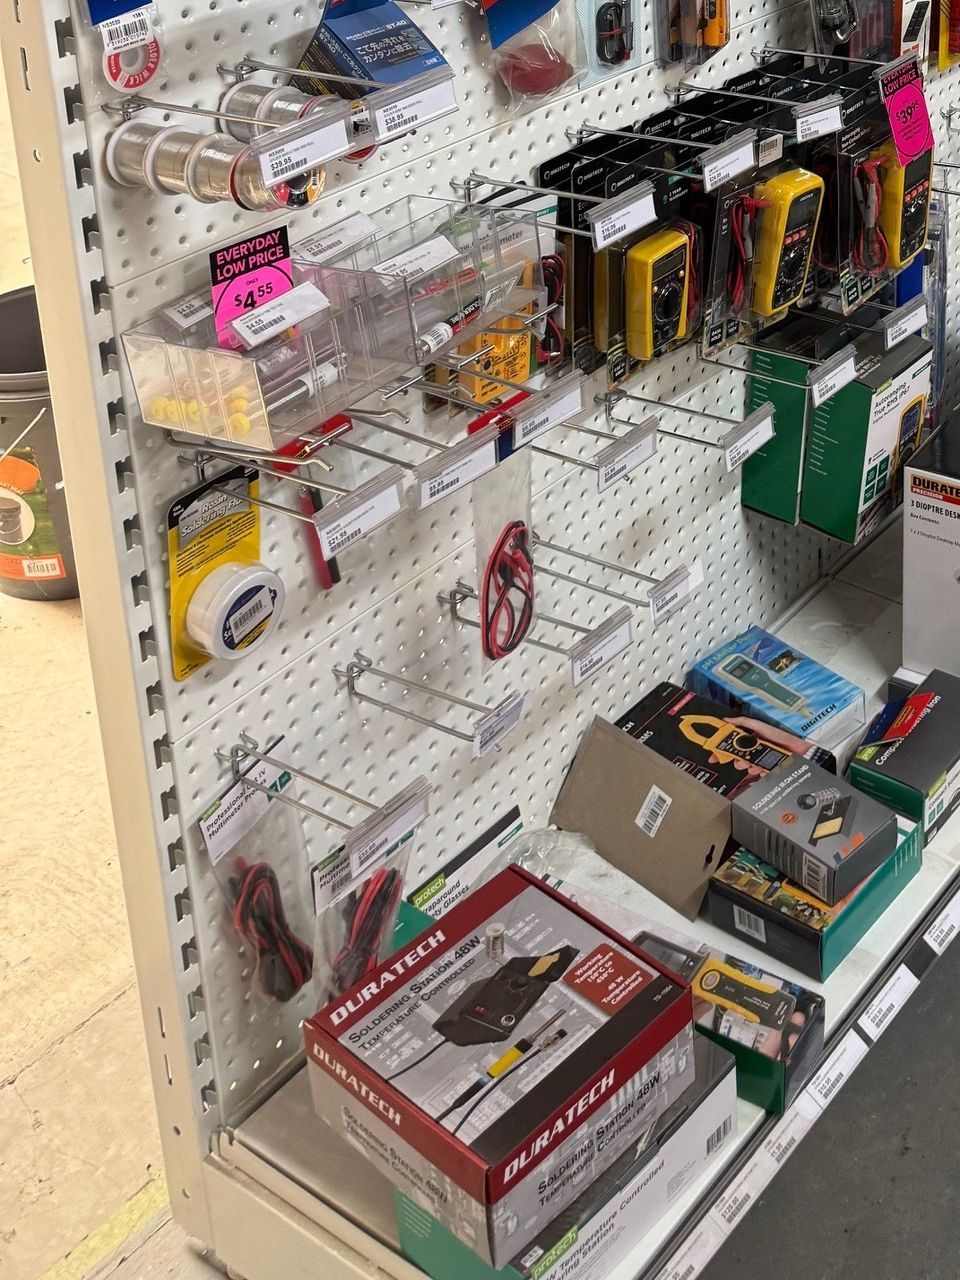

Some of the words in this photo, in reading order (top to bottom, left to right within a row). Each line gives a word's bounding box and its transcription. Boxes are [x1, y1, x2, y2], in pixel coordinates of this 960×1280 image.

[270, 156, 292, 170] $39.95
[216, 231, 281, 265] EVERYDAY
[217, 259, 246, 280] LOW
[248, 245, 284, 269] PRICE
[873, 406, 886, 418] True
[886, 395, 899, 409] RMS
[874, 381, 907, 409] Autoranging
[202, 494, 228, 514] Rosin
[910, 499, 915, 507] 3
[915, 500, 944, 516] DIOPTRE
[912, 487, 944, 500] PRECISION
[181, 506, 227, 538] Soldering
[328, 529, 348, 547] $21.95
[801, 703, 838, 733] DIGITECH
[752, 784, 780, 811] SOLDERING
[780, 775, 793, 790] IRON
[792, 764, 810, 779] STAND
[206, 784, 246, 833] Professional
[208, 795, 245, 840] Multimeter
[413, 876, 445, 907] protech
[423, 880, 461, 915] raparound
[442, 884, 470, 908] Glasses
[329, 929, 447, 1027] DURATECH
[574, 951, 614, 984] Temperature
[348, 993, 411, 1044] SOLDERING
[410, 959, 454, 994] STATION
[454, 935, 481, 961] 48W
[601, 970, 641, 1003] Temperature
[611, 976, 643, 1005] Controlled
[358, 1001, 422, 1052] TEMPERATURE
[421, 958, 475, 1002] CONTROLLED
[313, 1042, 402, 1126] DURATECH
[503, 1069, 616, 1185] DURATECH
[538, 1141, 595, 1195] SOLDERING
[596, 1101, 635, 1141] STATION
[636, 1071, 661, 1101] 48W
[343, 1106, 389, 1152] SOLDERING
[390, 1146, 425, 1184] STATION
[539, 1153, 595, 1208] TEMPERATURE
[597, 1103, 647, 1153] CONTROLLED
[559, 1210, 618, 1270] Temperature
[619, 1159, 665, 1211] Controlled
[533, 1231, 578, 1279] protech
[581, 1222, 616, 1259] Station
